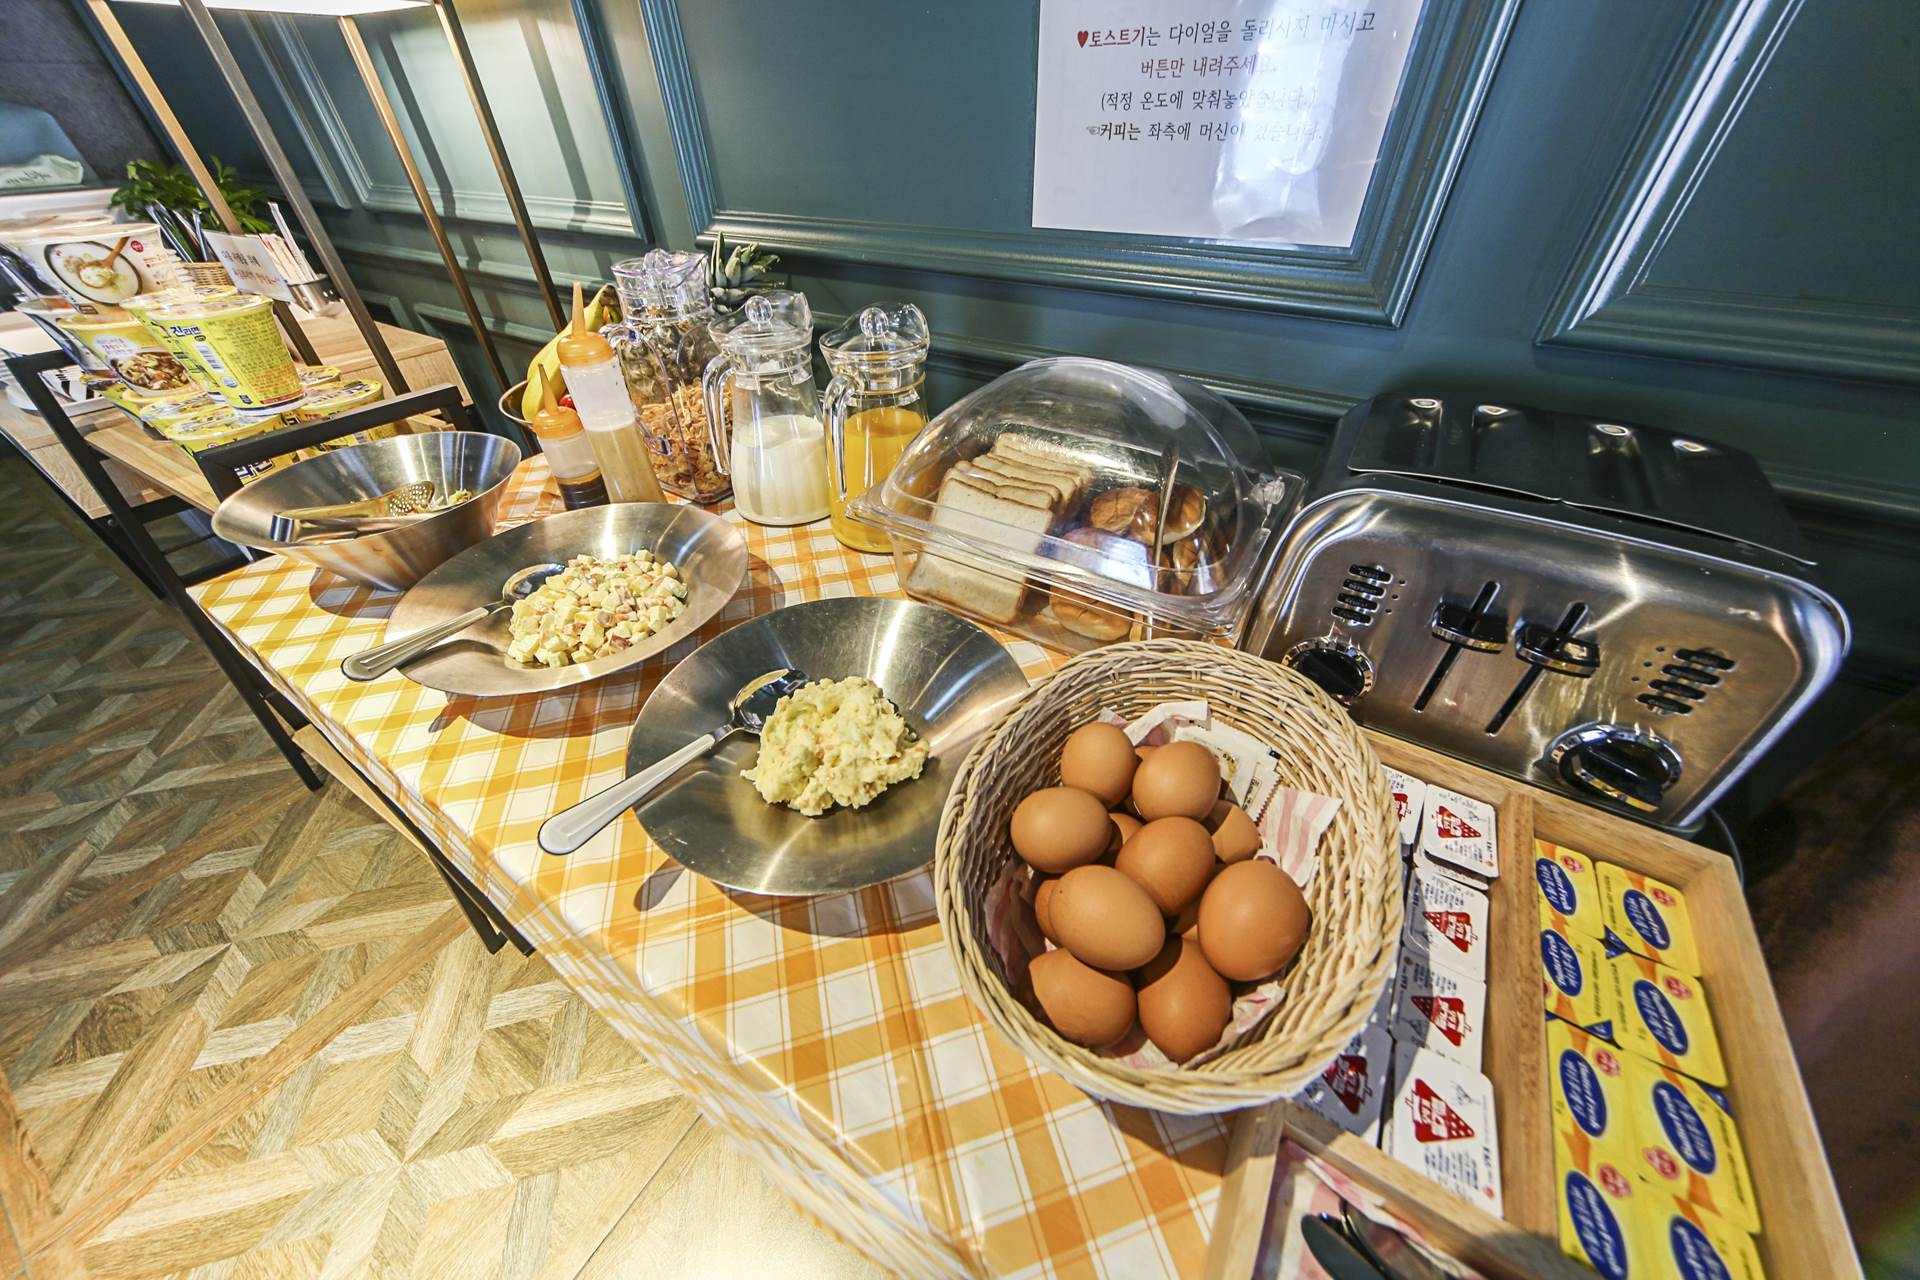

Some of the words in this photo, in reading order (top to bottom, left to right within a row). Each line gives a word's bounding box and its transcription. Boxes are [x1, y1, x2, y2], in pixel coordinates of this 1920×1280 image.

[1089, 26, 1160, 48] 토스트기는
[1169, 20, 1232, 46] 다이얼을
[1320, 10, 1377, 36] 마시고
[1141, 58, 1185, 79] 버튼만
[1101, 91, 1133, 112] (적정
[1140, 90, 1184, 111] 온도에
[1100, 121, 1141, 141] 커피는
[1148, 121, 1192, 141] 좌측에
[1199, 121, 1245, 142] 머신이
